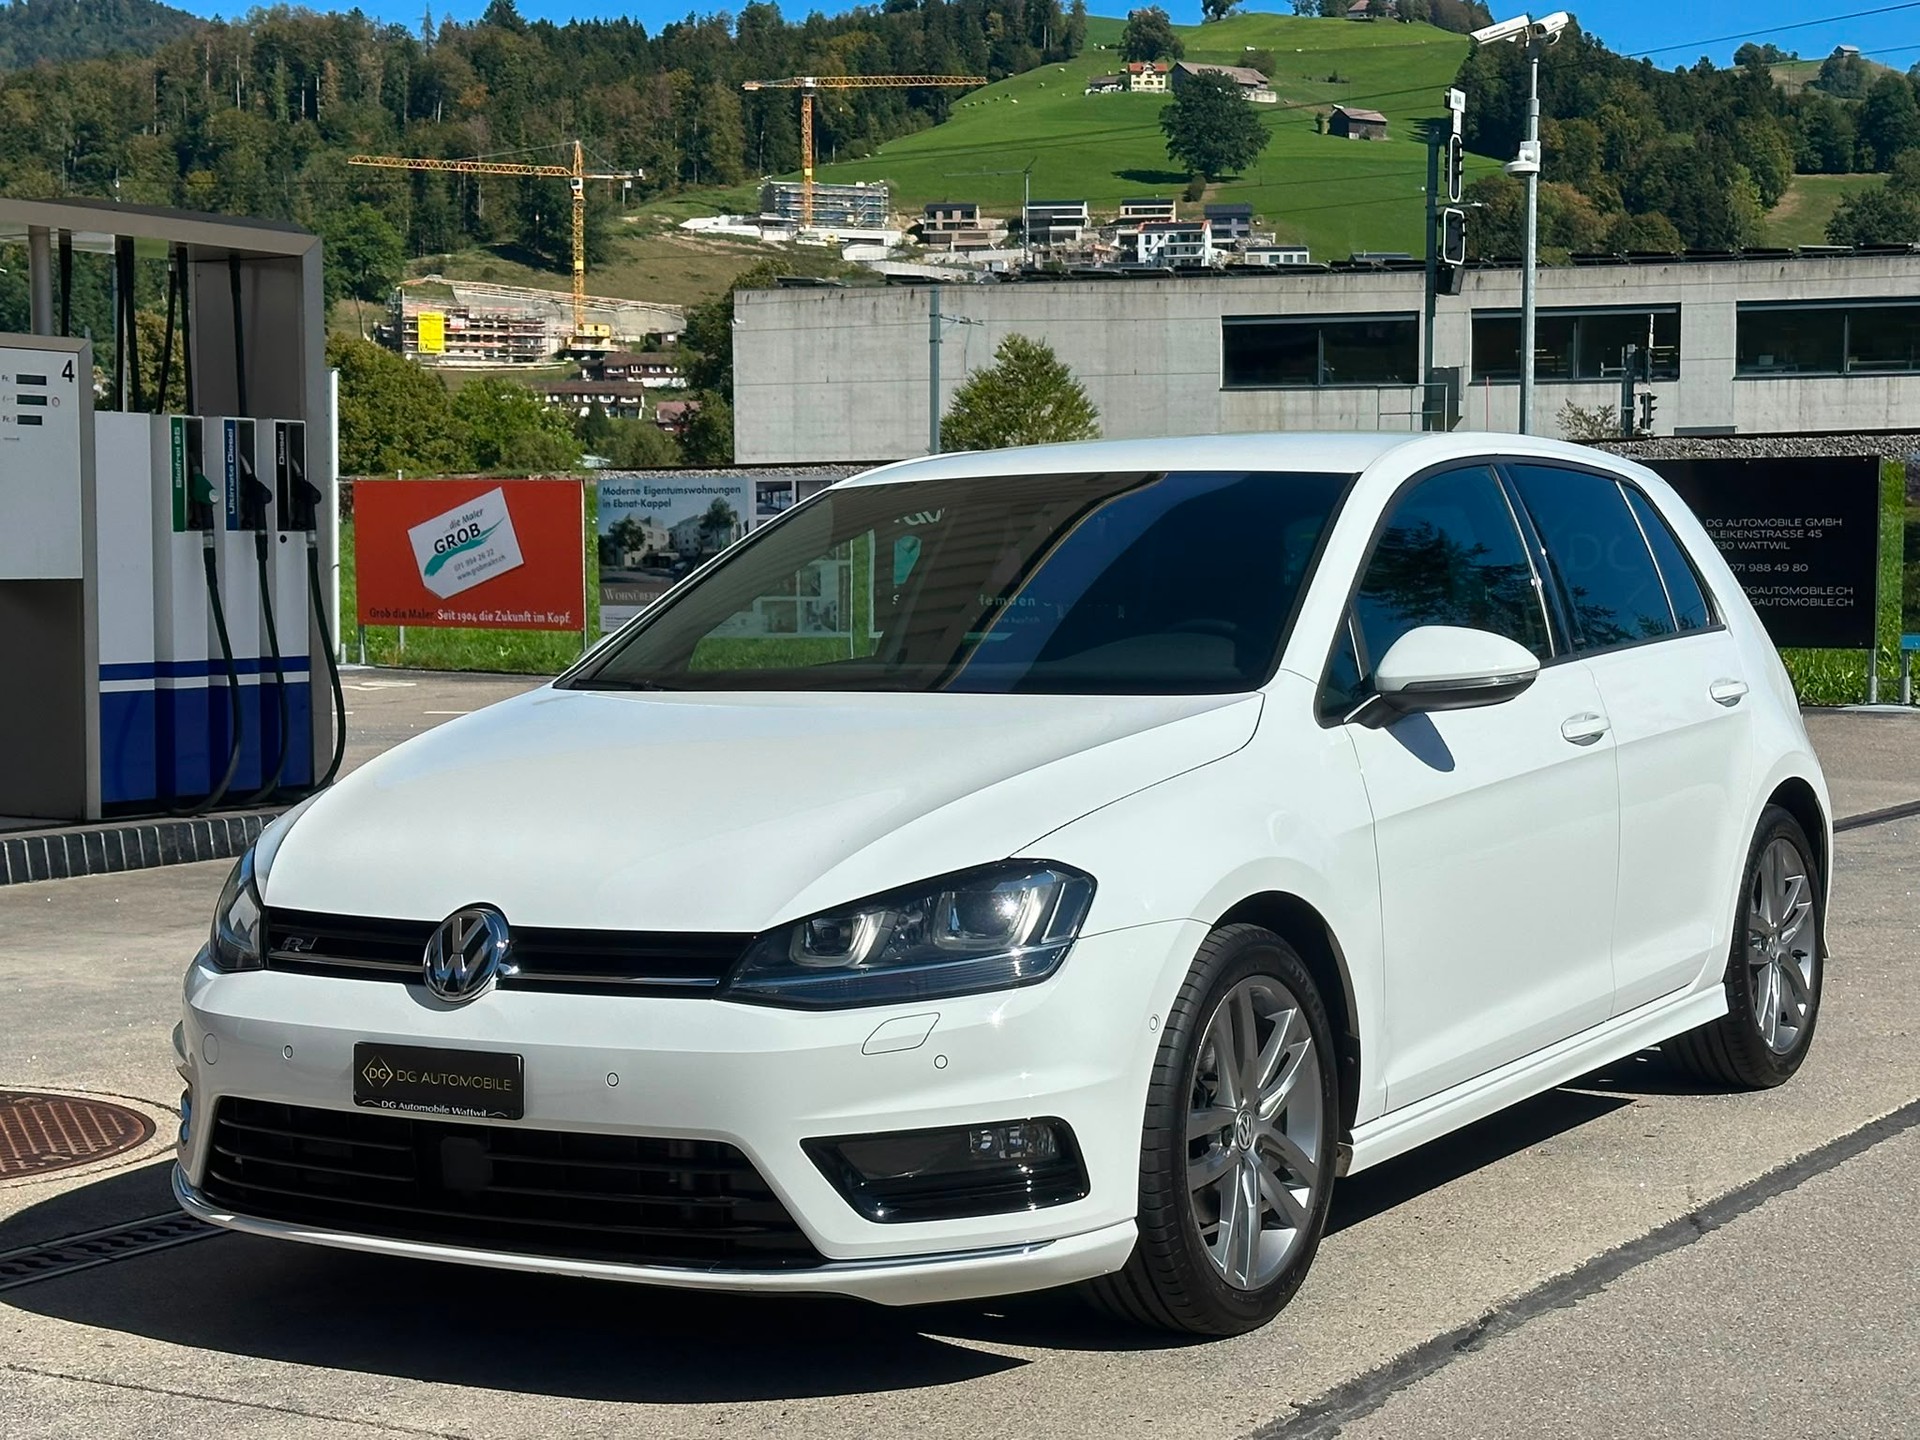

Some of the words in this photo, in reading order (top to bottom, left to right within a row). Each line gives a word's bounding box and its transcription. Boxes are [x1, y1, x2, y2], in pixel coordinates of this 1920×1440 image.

[60, 359, 75, 383] 4
[173, 426, 182, 444] 95
[173, 447, 183, 489] Bleifrei
[226, 465, 236, 514] Ultimate
[602, 486, 641, 496] Moderne
[643, 485, 741, 497] Eigentumswohnungen
[602, 500, 611, 508] in
[613, 499, 672, 510] Ebnat-Kappel
[462, 508, 484, 523] Maler
[1705, 518, 1723, 528] DG
[1726, 518, 1801, 527] AUTOMOBILE
[1805, 518, 1842, 527] GMBH
[433, 522, 481, 554] GROB
[1807, 529, 1823, 538] 45
[1738, 541, 1791, 550] WATTWIL
[1748, 563, 1771, 572] 988
[1774, 563, 1790, 572] 49
[1792, 563, 1809, 572] 80
[369, 607, 391, 619] Grob
[392, 608, 407, 619] die
[437, 609, 456, 620] Seit
[458, 611, 477, 623] 1904
[479, 610, 493, 621] die
[495, 610, 531, 623] Zukunft
[533, 611, 545, 622] im
[368, 1067, 387, 1080] DG
[396, 1069, 417, 1083] DG
[420, 1072, 513, 1091] AUTOMOBILE
[381, 1100, 397, 1109] DG
[398, 1102, 450, 1114] Automobile
